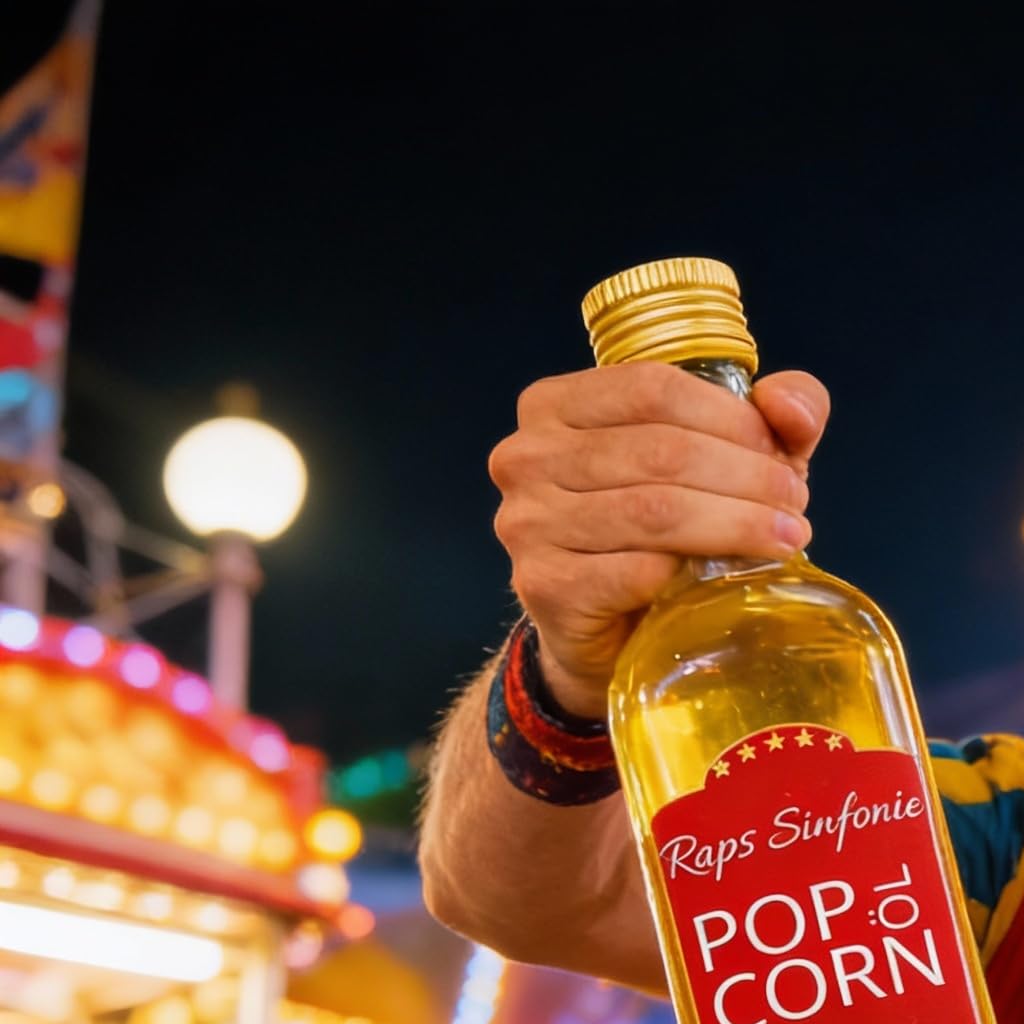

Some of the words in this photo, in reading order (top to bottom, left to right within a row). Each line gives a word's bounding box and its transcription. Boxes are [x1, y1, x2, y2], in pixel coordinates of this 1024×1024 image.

[659, 829, 757, 881] Raps
[768, 791, 925, 853] Sinfonie
[693, 880, 855, 973] POP
[867, 863, 919, 929] ÖL
